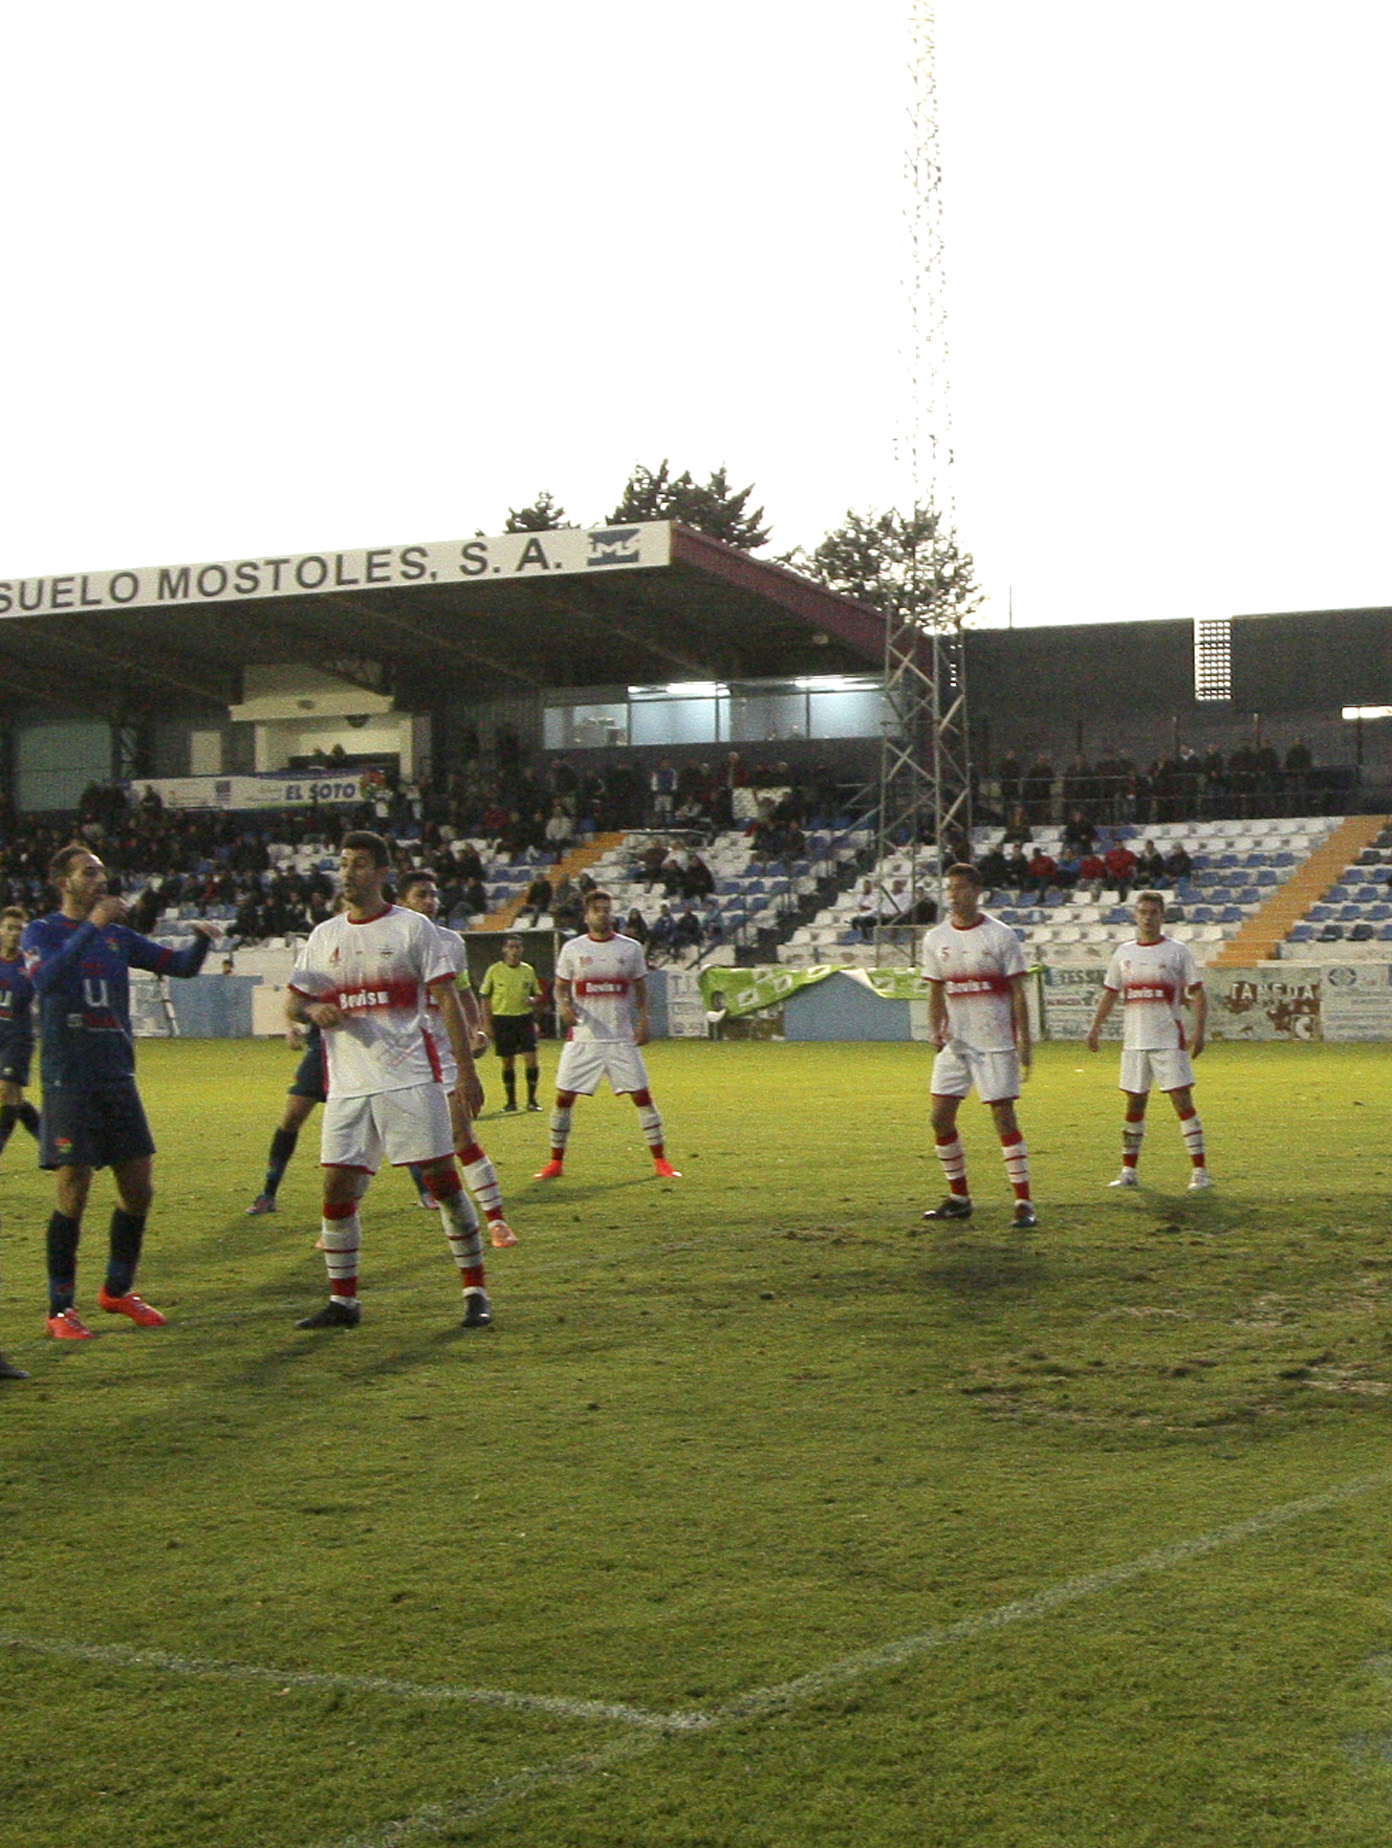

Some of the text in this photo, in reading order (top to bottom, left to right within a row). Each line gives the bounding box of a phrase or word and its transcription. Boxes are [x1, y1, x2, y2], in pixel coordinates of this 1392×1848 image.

[157, 546, 437, 600] MOSTOLES,
[459, 540, 500, 576] S.
[515, 536, 562, 572] A.
[286, 784, 303, 800] EL
[310, 783, 356, 800] SOTO
